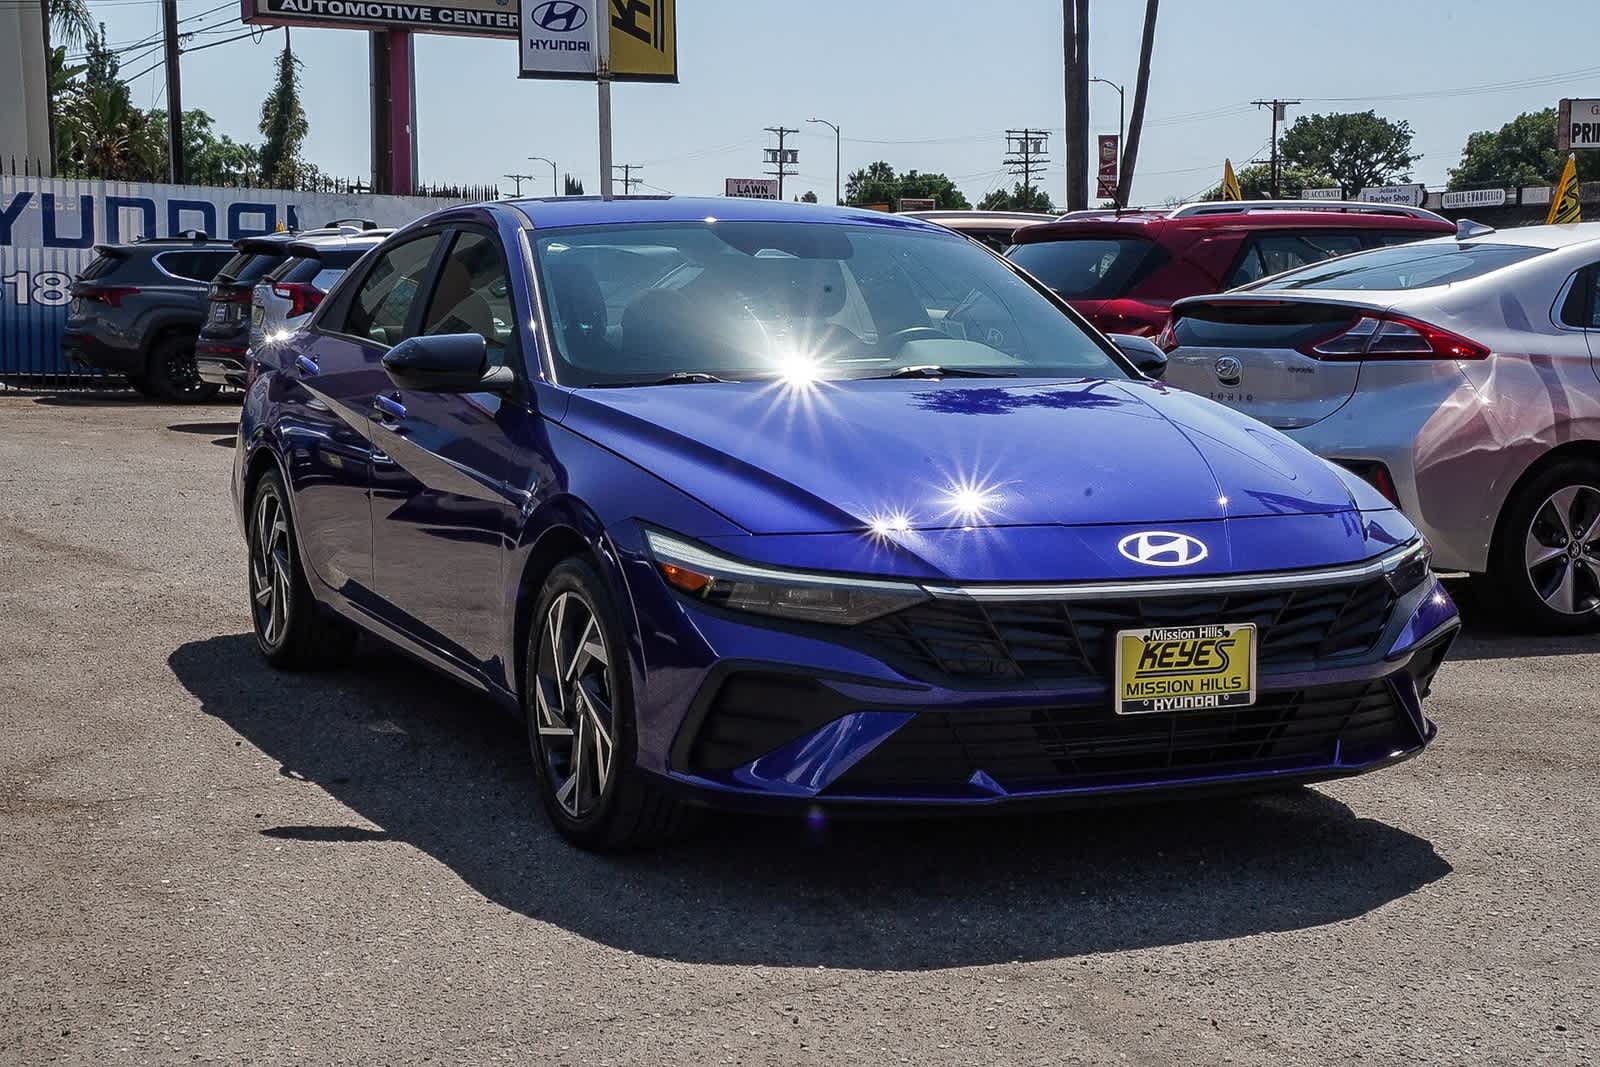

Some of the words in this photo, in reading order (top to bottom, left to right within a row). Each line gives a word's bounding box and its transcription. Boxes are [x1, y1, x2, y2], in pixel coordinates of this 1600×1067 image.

[280, 0, 432, 21] AUTOMOTIVE
[438, 9, 519, 27] CENTER
[529, 39, 590, 52] HYUNDAI
[1571, 122, 1600, 144] PRI
[737, 184, 768, 194] LAWN
[1393, 193, 1410, 203] Shop
[0, 271, 73, 306] 18
[1151, 629, 1195, 641] Mission
[1199, 627, 1223, 639] Hills
[1136, 640, 1236, 676] KEYES
[1126, 679, 1194, 696] MISSION
[1200, 677, 1242, 691] HILLS
[1154, 695, 1219, 711] HYUNDAI
